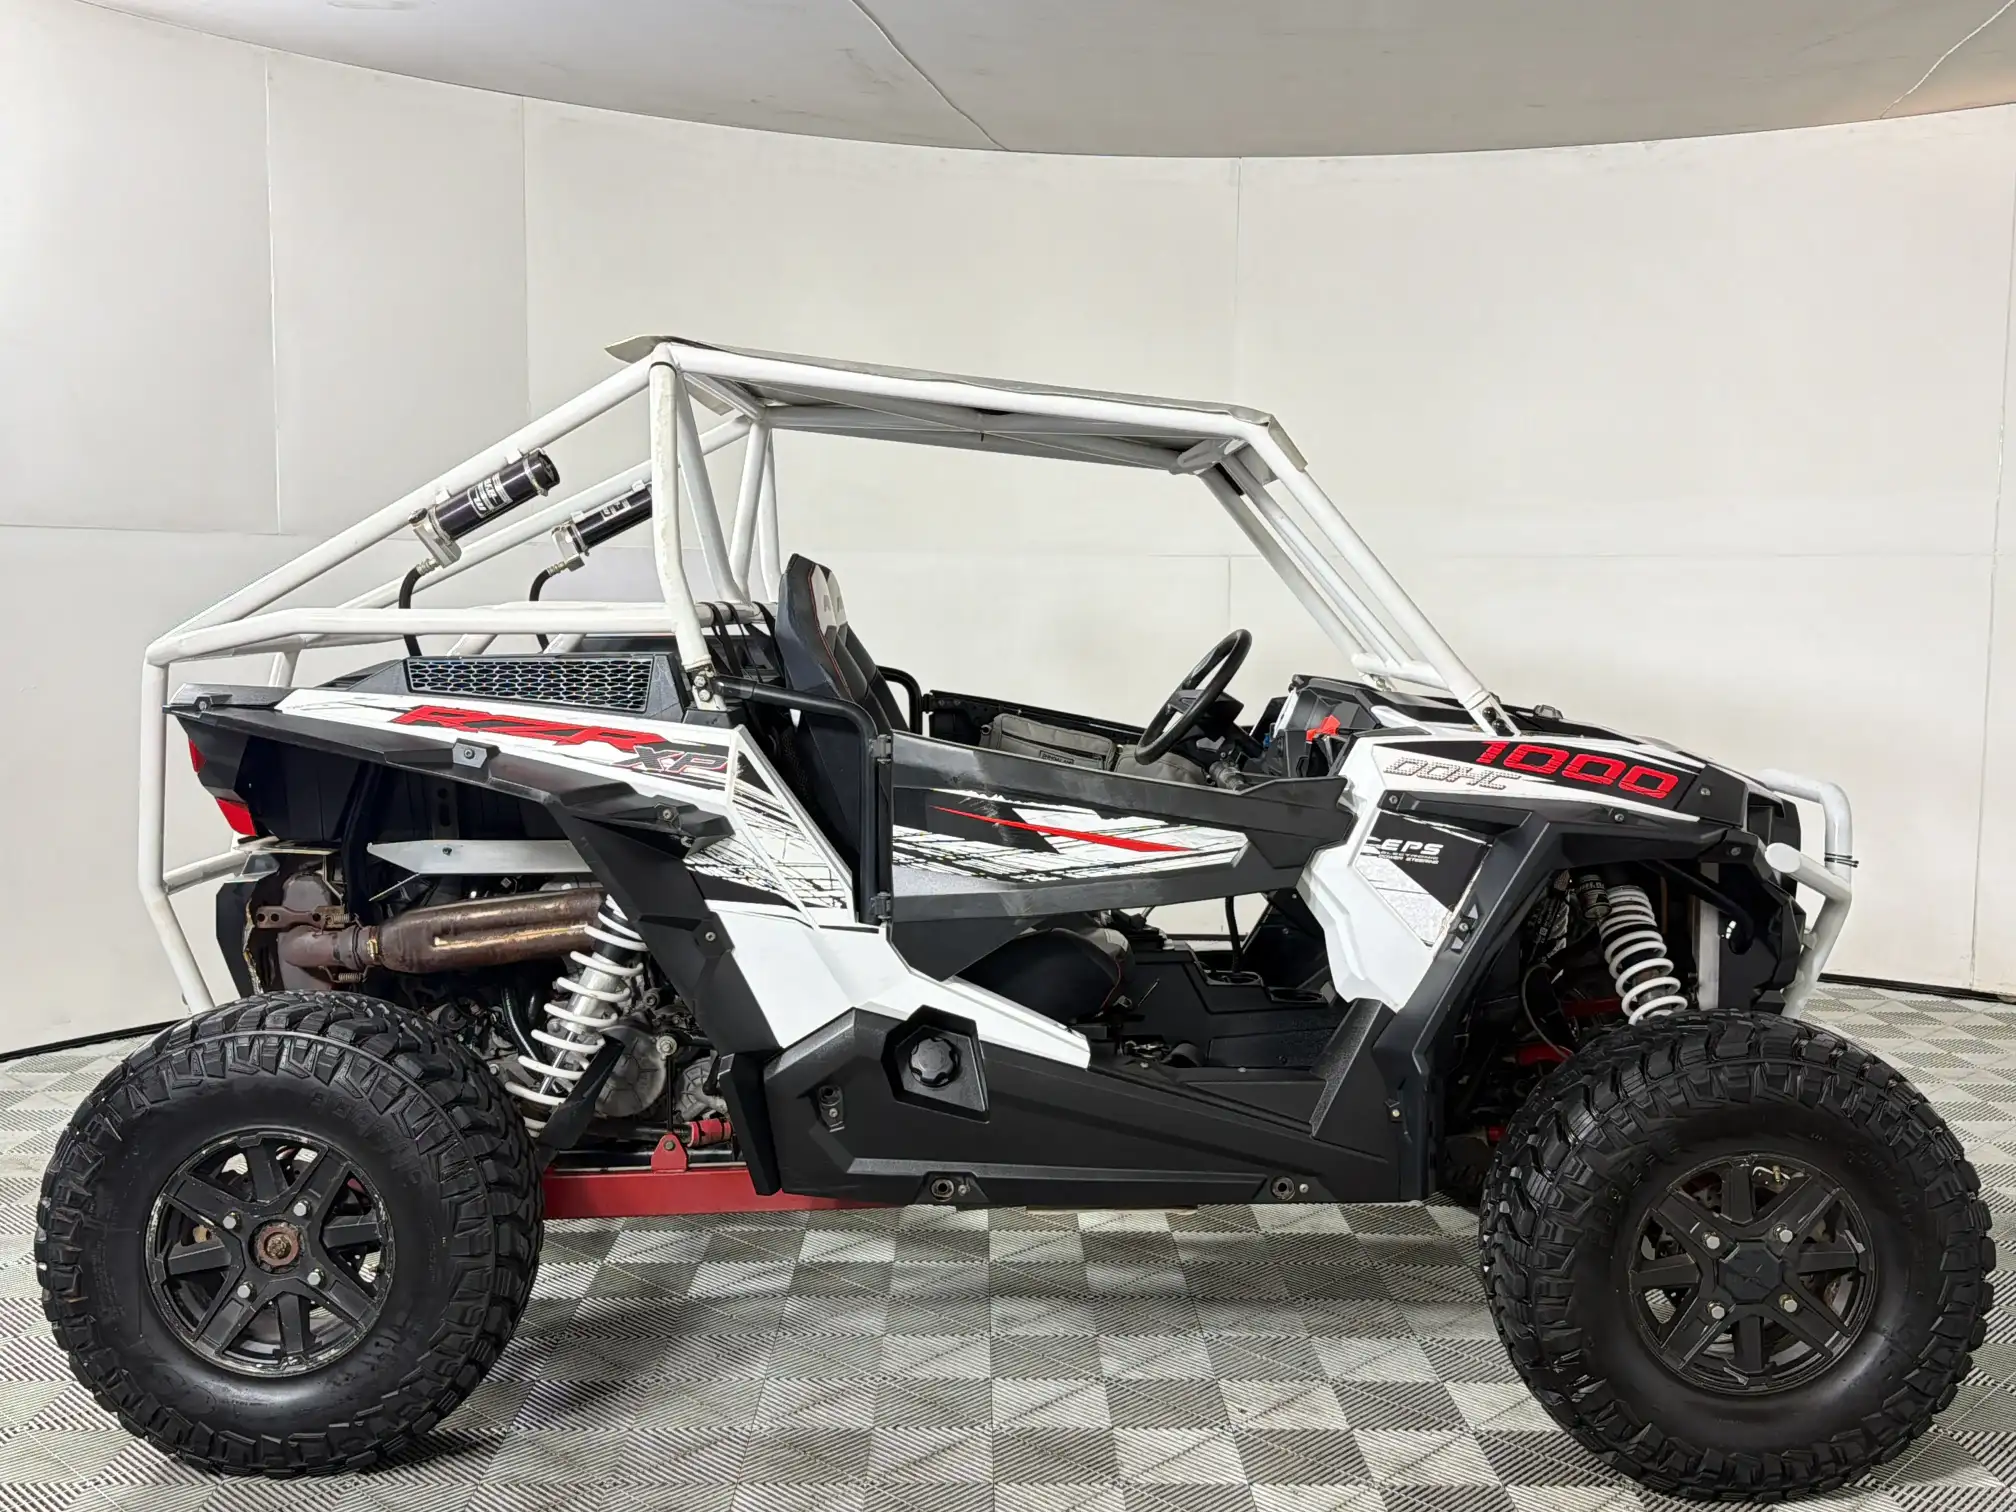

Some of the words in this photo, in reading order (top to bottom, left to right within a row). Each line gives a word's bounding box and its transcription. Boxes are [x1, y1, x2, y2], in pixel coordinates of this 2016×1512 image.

[388, 704, 667, 752] RZR
[614, 745, 729, 774] XP
[1383, 757, 1521, 790] DOHC
[1475, 741, 1679, 799] 1000
[1381, 838, 1445, 856] EPS
